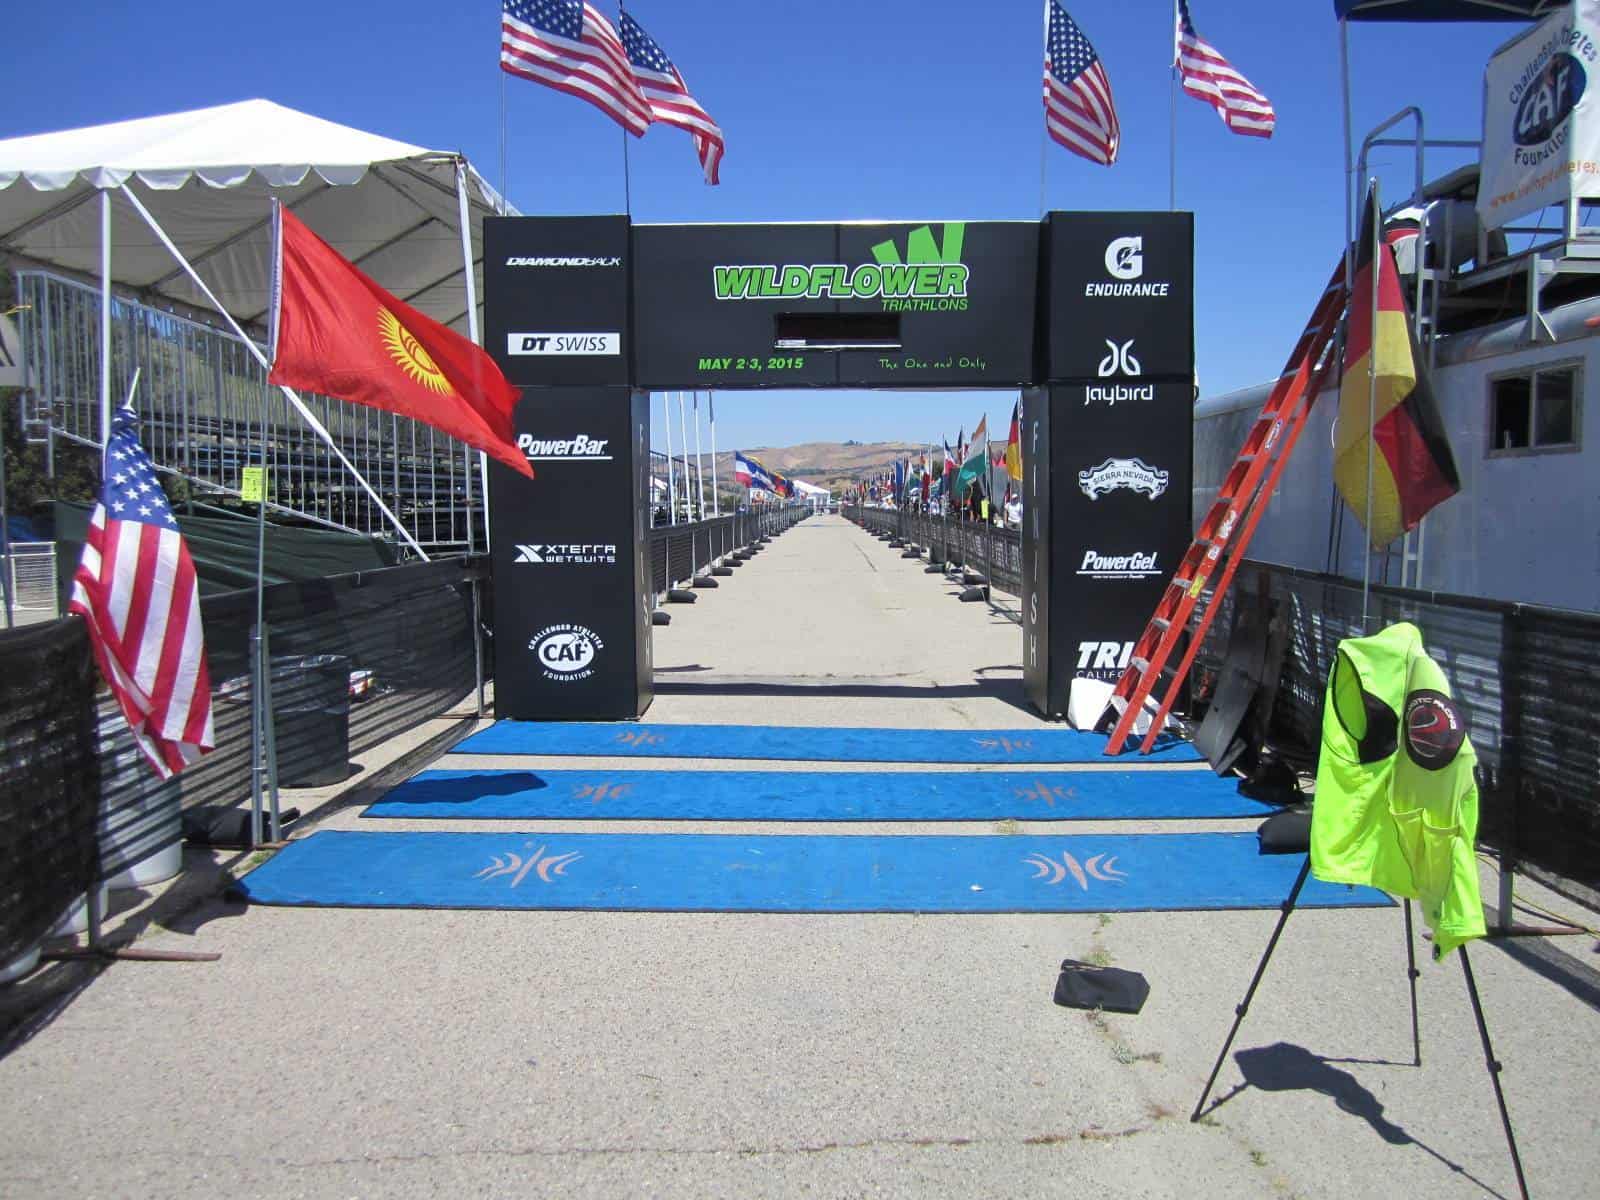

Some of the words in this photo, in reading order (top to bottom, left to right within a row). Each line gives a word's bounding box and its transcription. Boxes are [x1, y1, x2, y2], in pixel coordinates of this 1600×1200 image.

[713, 264, 969, 299] WILDFLOWER
[1084, 283, 1170, 297] ENDURANCE
[881, 298, 969, 312] TRIATHLONS
[521, 336, 552, 352] DT
[555, 336, 608, 352] SWISS
[698, 358, 732, 370] MAY
[767, 357, 805, 369] 2015
[879, 358, 898, 370] The
[904, 358, 928, 369] One
[933, 356, 954, 369] and
[959, 356, 986, 371] Only
[518, 433, 609, 456] PowerBar
[1092, 470, 1122, 485] SIERRA
[545, 544, 617, 554] XTERRA
[545, 555, 617, 563] WETSUITS
[1081, 550, 1158, 570] PowerGel
[543, 643, 587, 662] CAF
[1076, 641, 1136, 669] TRI
